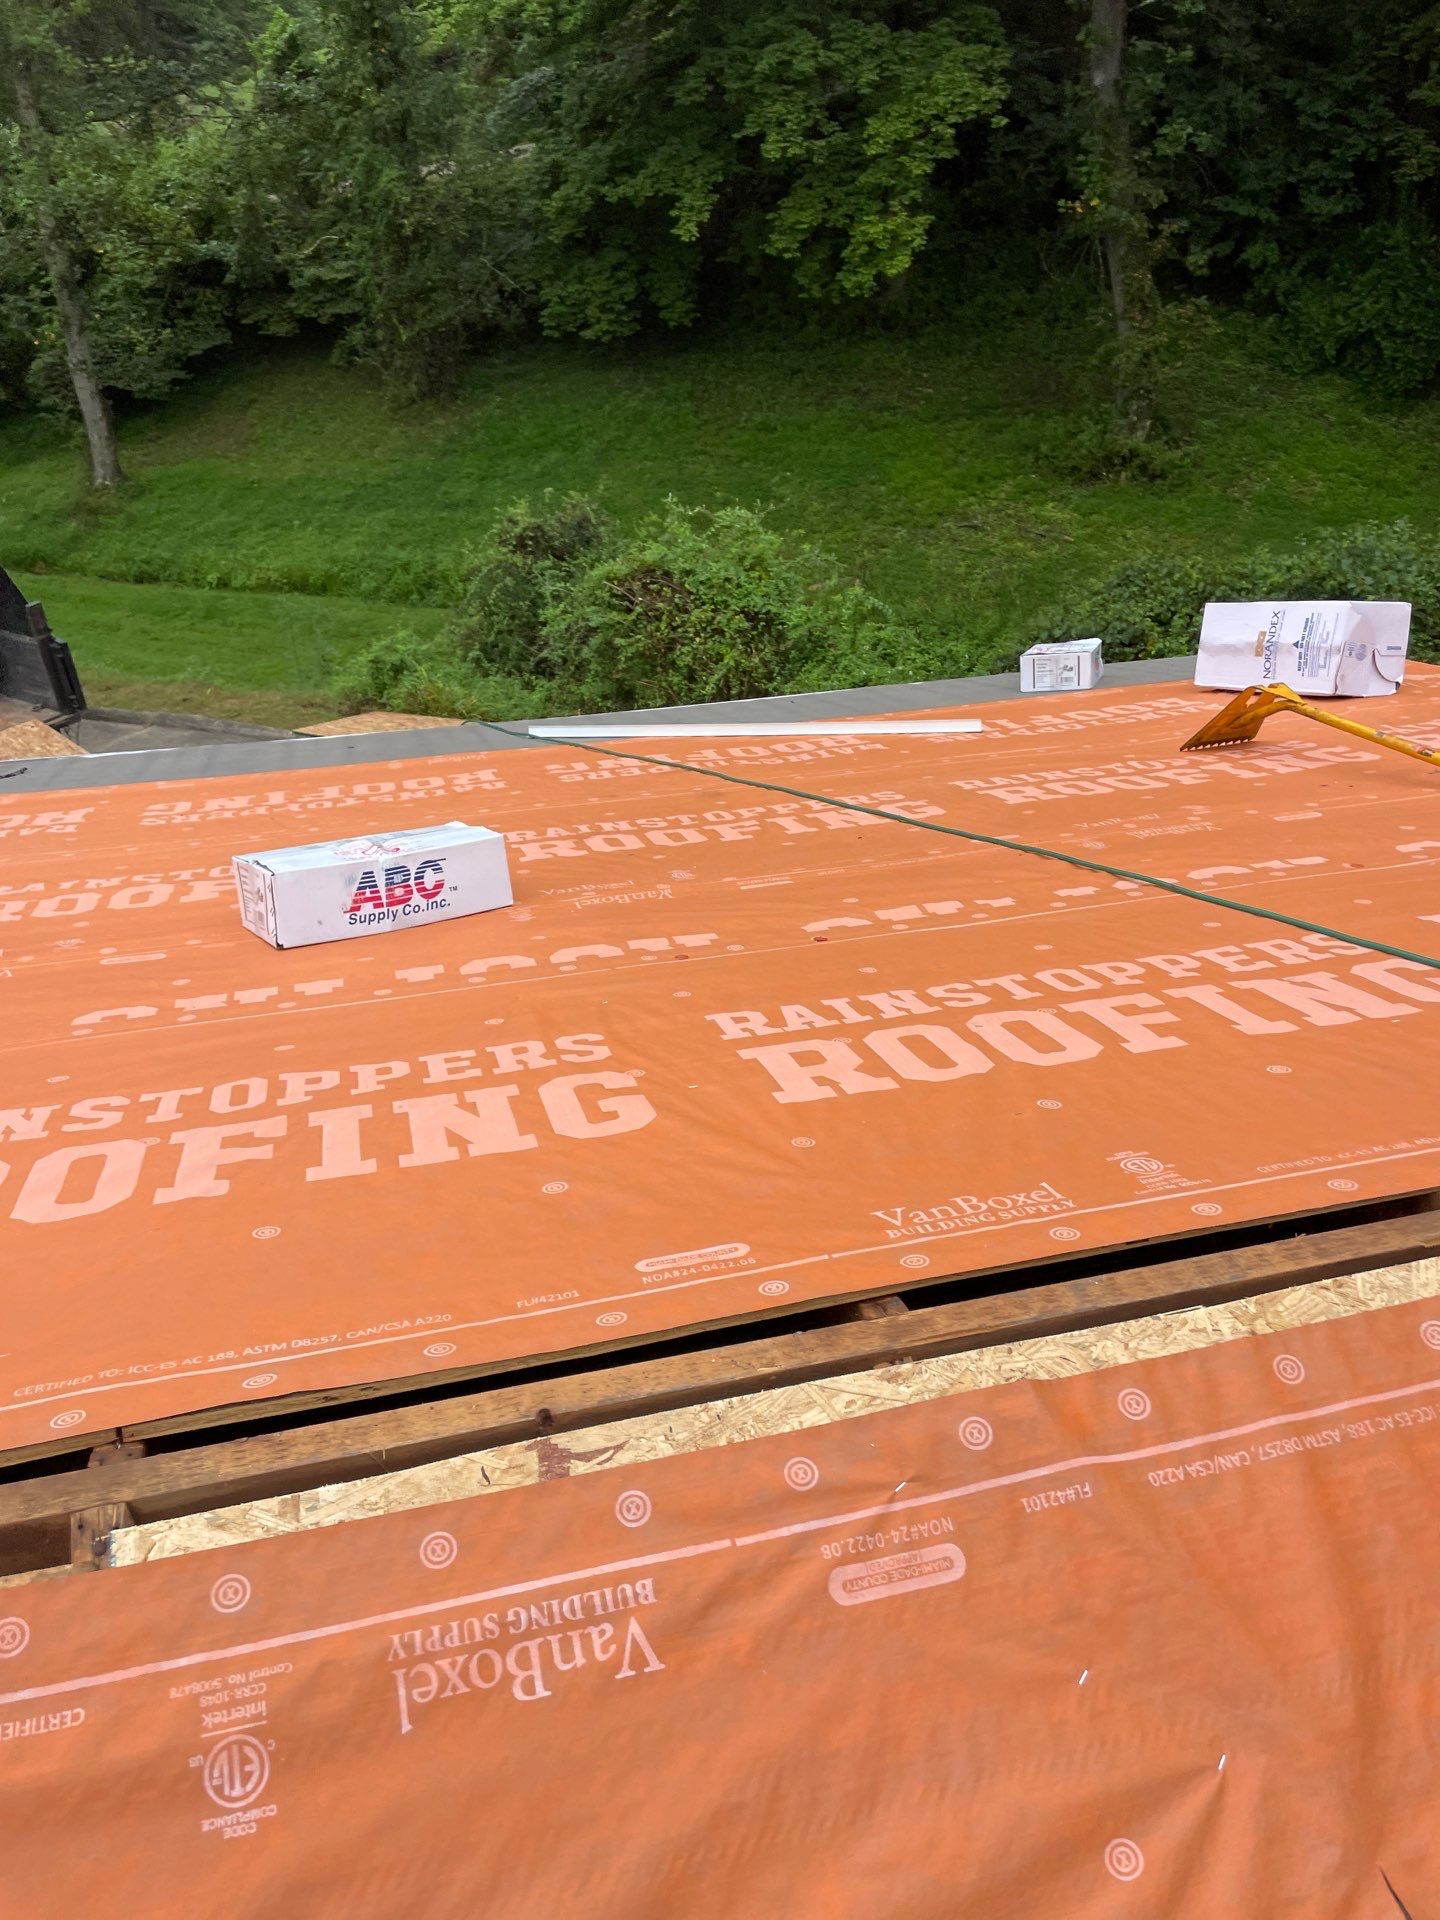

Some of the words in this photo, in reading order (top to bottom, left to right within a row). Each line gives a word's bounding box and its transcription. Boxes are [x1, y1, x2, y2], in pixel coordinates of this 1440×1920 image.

[1263, 610, 1281, 679] NORANDEX
[976, 746, 1382, 804] ROOFING
[505, 791, 905, 843] RAINSTOPPERS
[511, 800, 947, 862] ROOFING
[344, 858, 447, 914] ABC
[348, 908, 399, 925] Supply
[705, 932, 1376, 1041] RAINSTOPPERS
[0, 1070, 657, 1224] OFING
[870, 1181, 1067, 1227] VanBoxel
[885, 1212, 996, 1239] BUILDING
[998, 1199, 1077, 1220] SUPPLY
[13, 1374, 93, 1398] CERTIFIED
[97, 1367, 125, 1379] TO:
[128, 1360, 177, 1375] ICC-ES
[181, 1355, 204, 1366] AC
[242, 1341, 287, 1357] ASTM
[346, 1319, 412, 1340] CAN/CSA
[414, 1313, 453, 1327] A220
[1300, 1427, 1342, 1449] ASTM
[1376, 1415, 1395, 1432] AC
[1148, 1465, 1185, 1488] A220
[1185, 1450, 1250, 1478] CAN/CSA
[1020, 1481, 1093, 1514] FL#42101
[820, 1516, 955, 1561] NOA#24-0422.08
[846, 1573, 891, 1592] COUNTY
[891, 1558, 952, 1584] MIAMI-DADE
[505, 1577, 658, 1635] BUILDING
[387, 1612, 501, 1662] SUPPLY
[248, 1662, 294, 1683] Control
[391, 1616, 667, 1735] VanBoxel
[0, 1707, 85, 1740] CERTIFIE
[200, 1803, 278, 1832] COMPLIANCE
[223, 1821, 258, 1839] CODE
